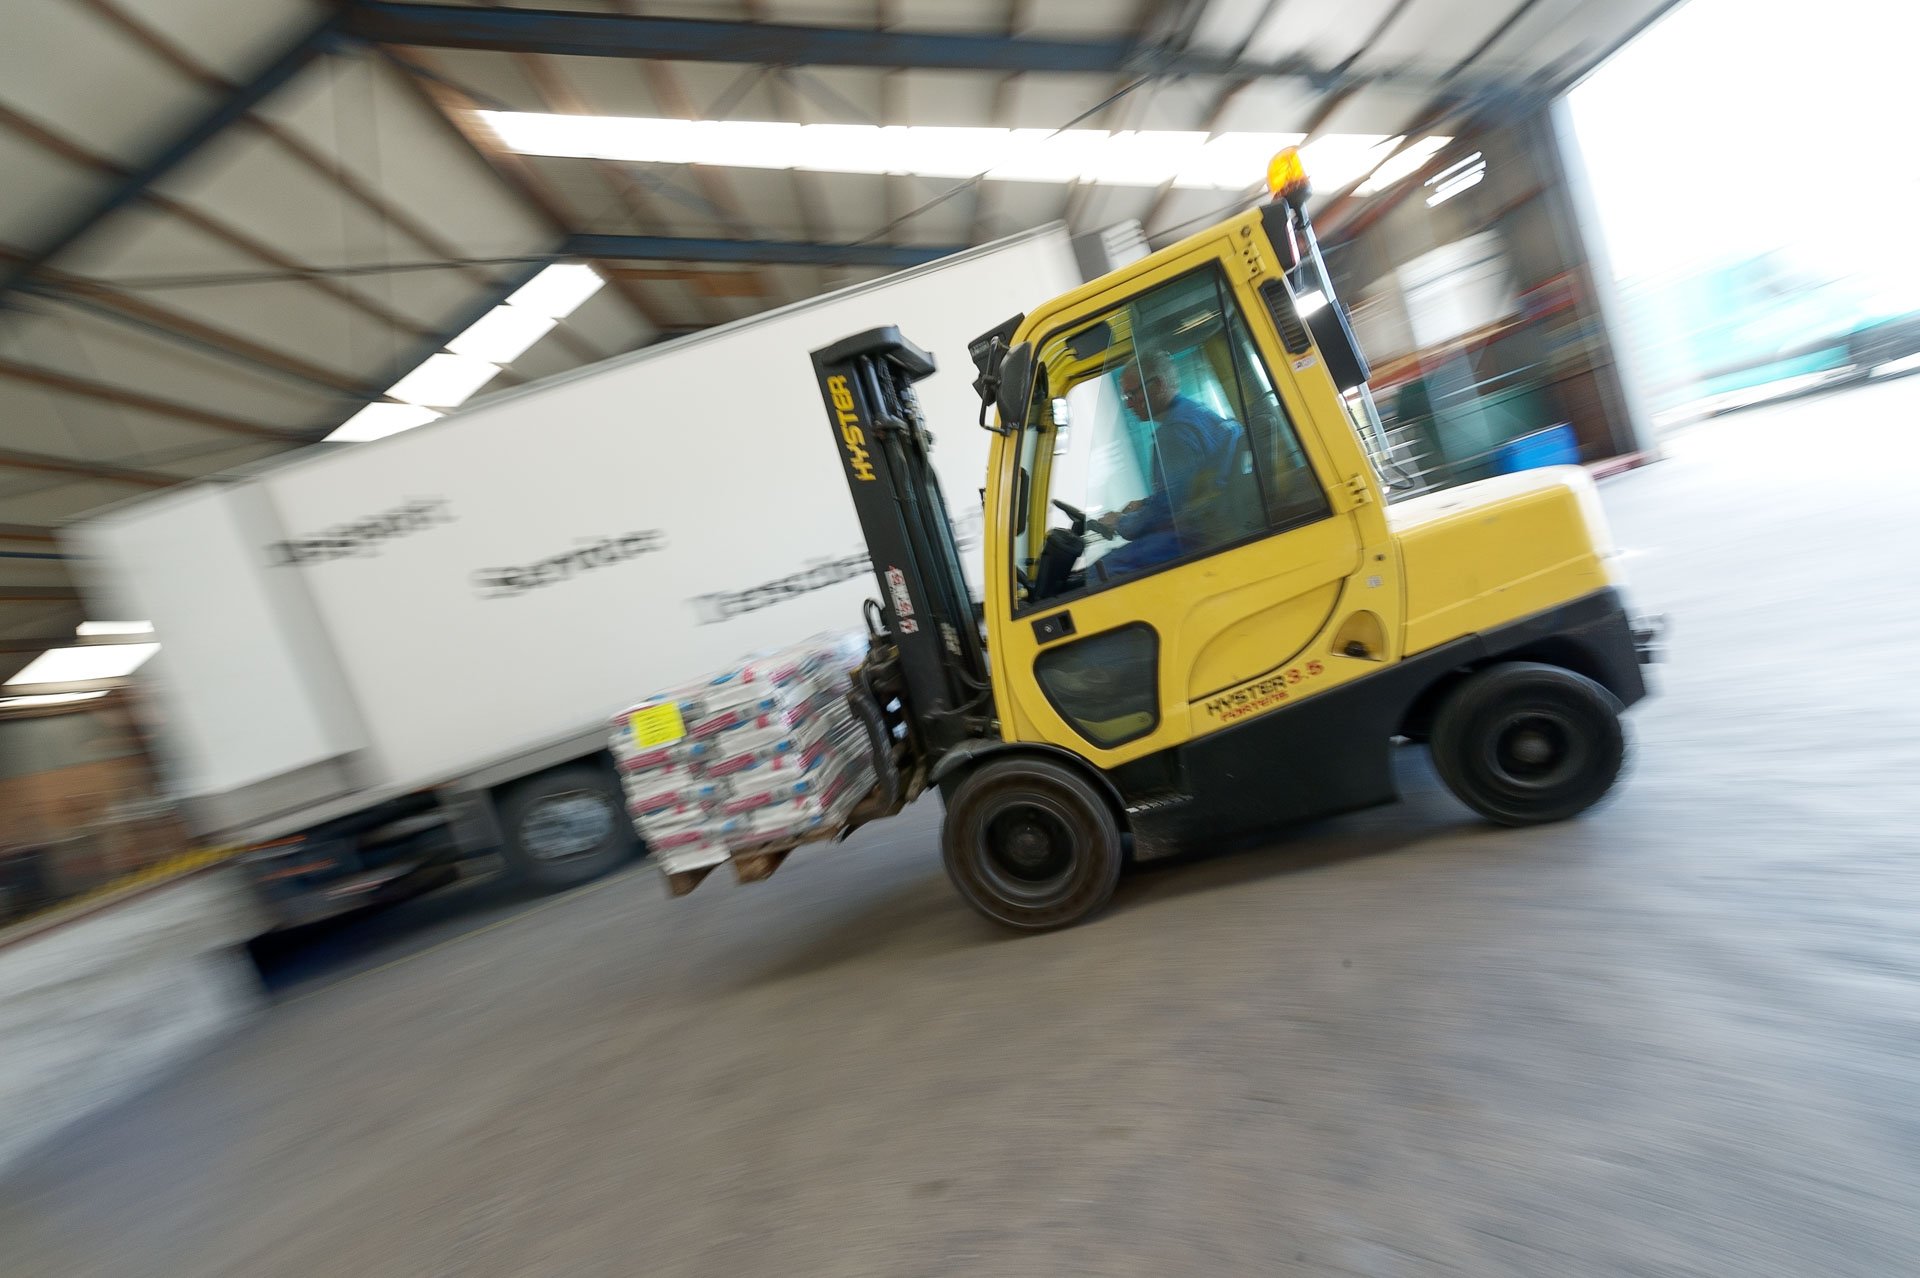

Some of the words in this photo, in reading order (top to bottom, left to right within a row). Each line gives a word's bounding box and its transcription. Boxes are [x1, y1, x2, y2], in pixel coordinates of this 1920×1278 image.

[827, 374, 877, 481] HYSTER
[1205, 675, 1287, 716] HYSTER
[1286, 659, 1325, 684] 3.5
